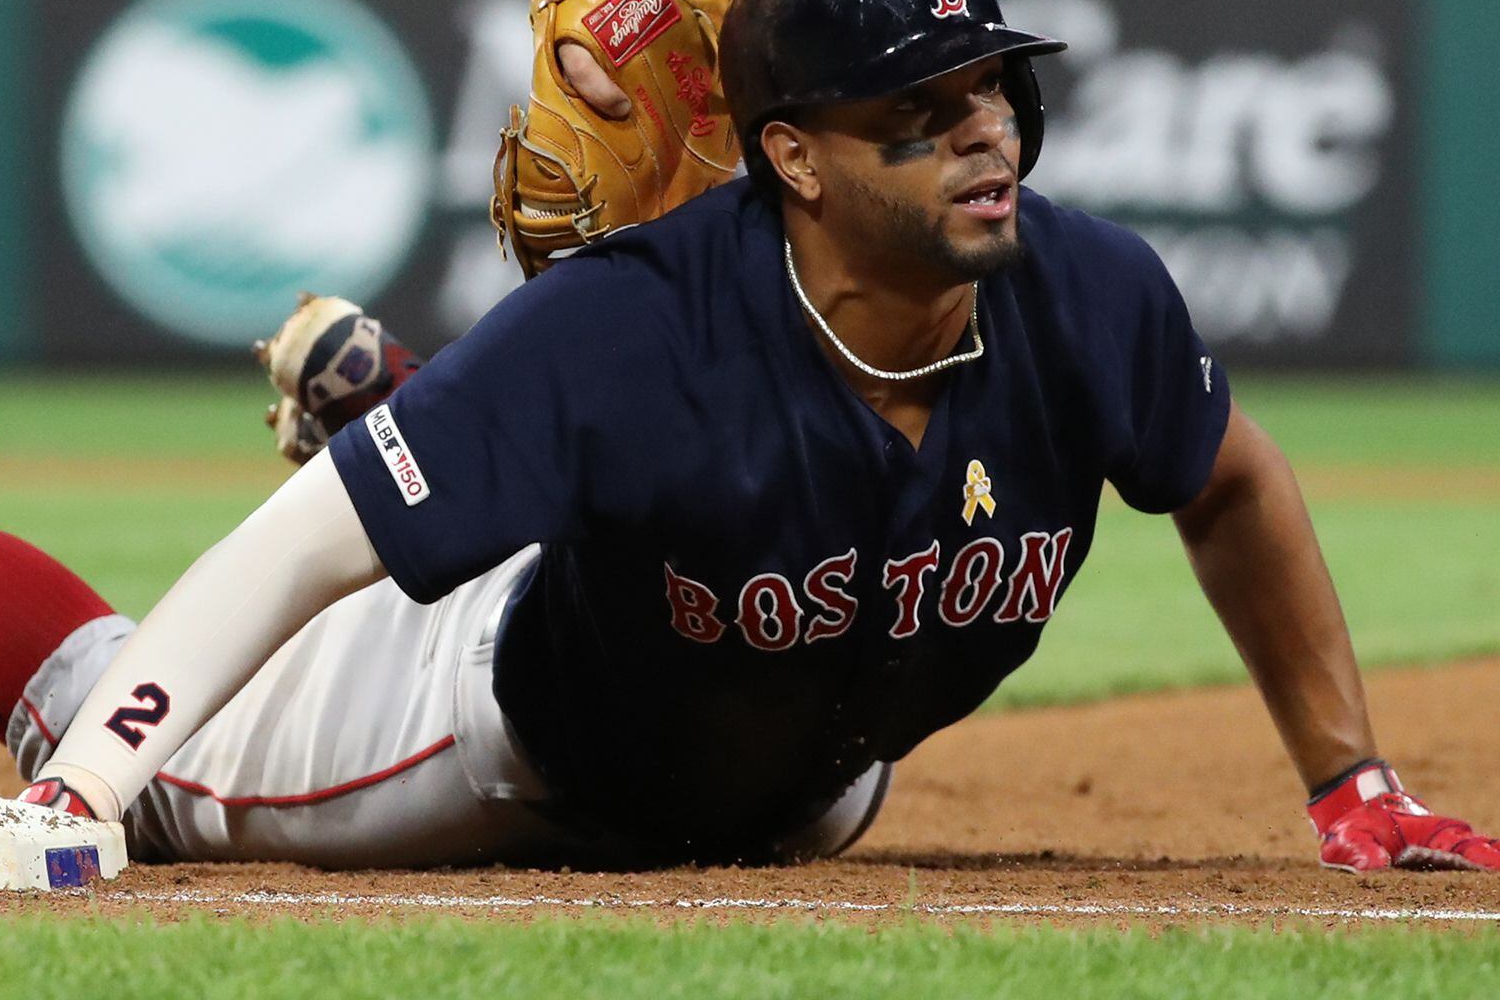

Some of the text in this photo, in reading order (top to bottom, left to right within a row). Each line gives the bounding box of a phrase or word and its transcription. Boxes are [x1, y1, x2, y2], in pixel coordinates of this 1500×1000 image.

[370, 409, 423, 497] MLB 150
[663, 526, 1073, 652] BOSTON
[103, 682, 170, 751] 2
